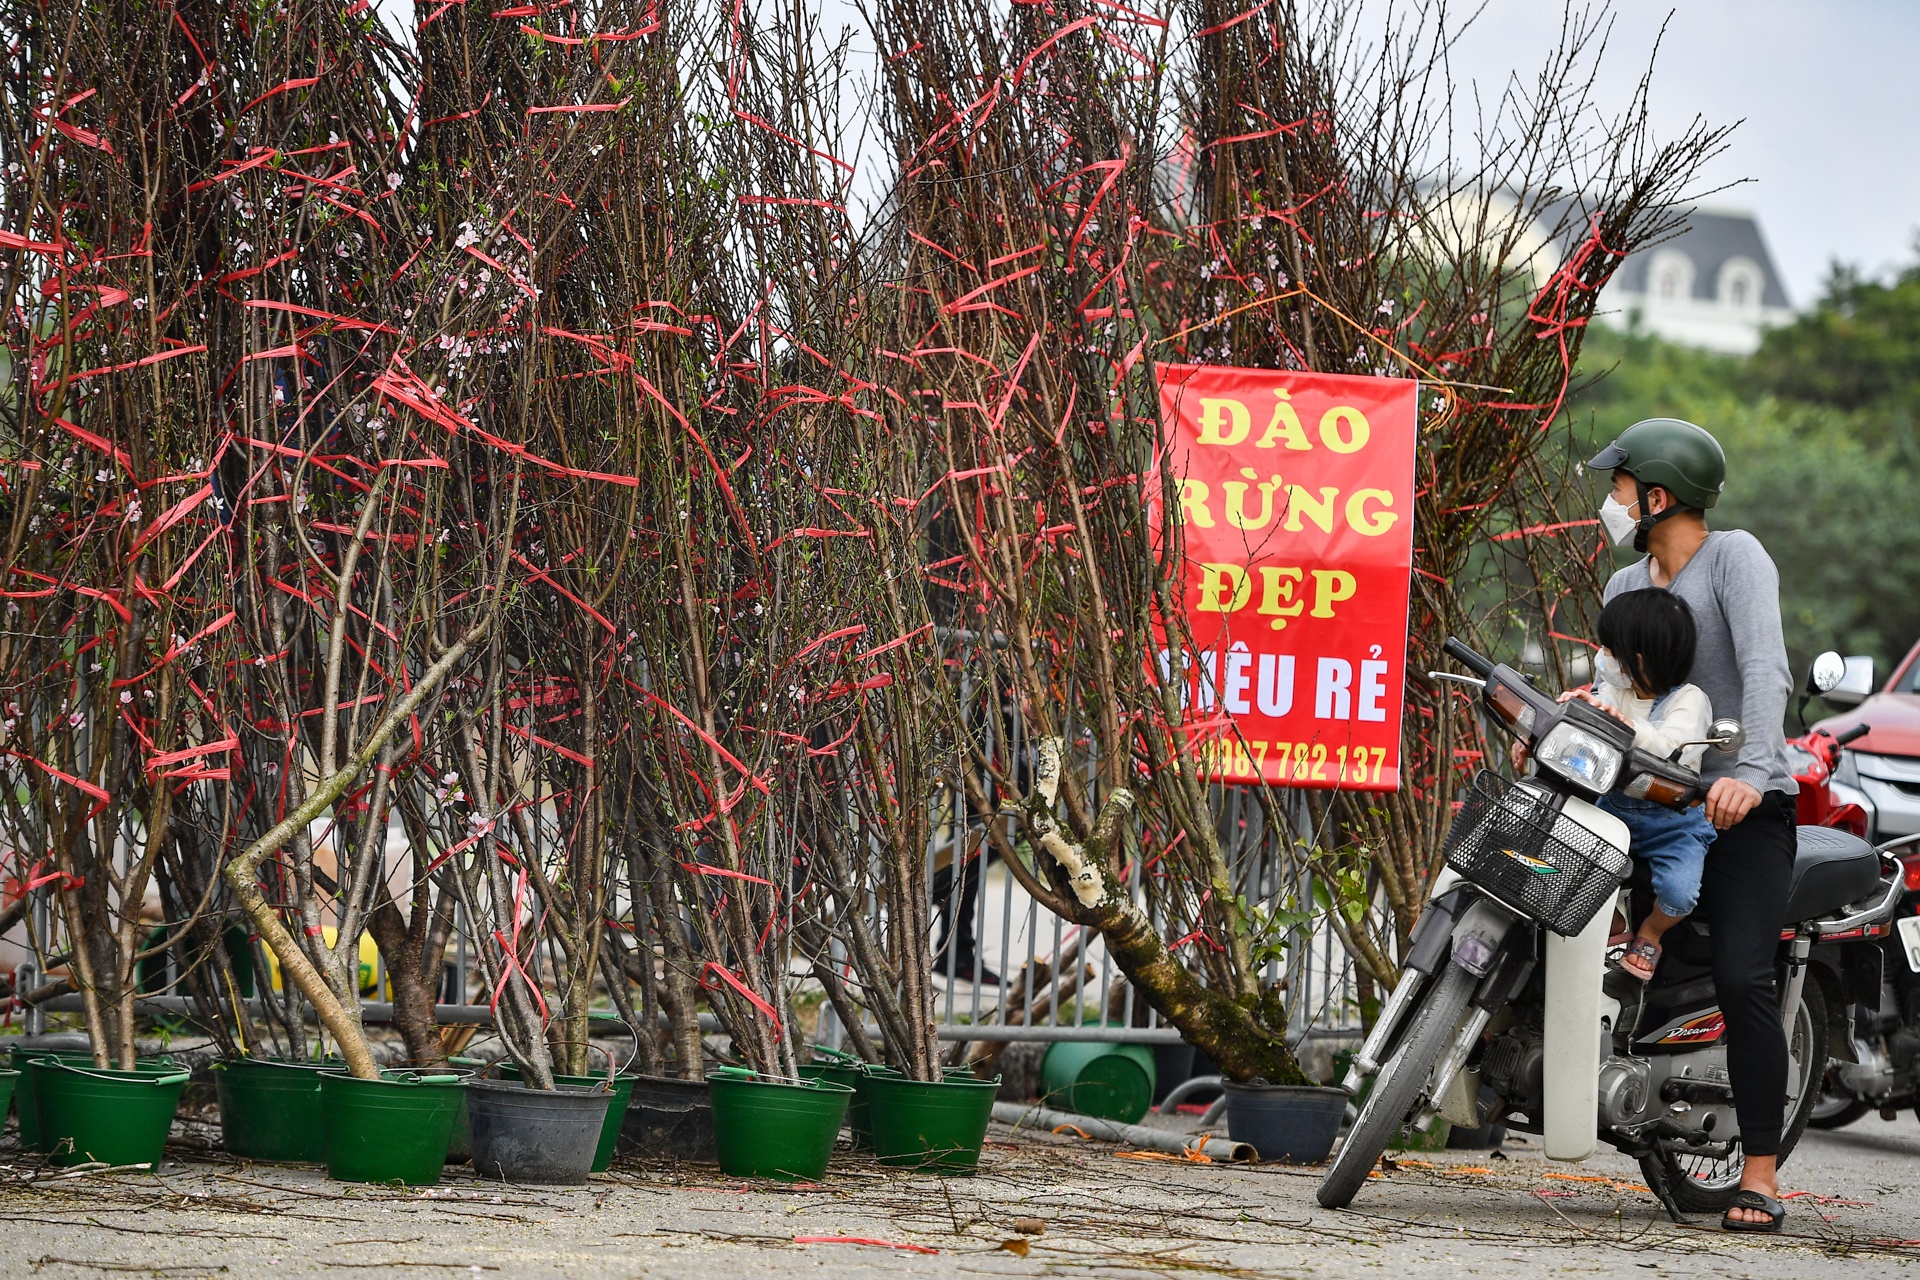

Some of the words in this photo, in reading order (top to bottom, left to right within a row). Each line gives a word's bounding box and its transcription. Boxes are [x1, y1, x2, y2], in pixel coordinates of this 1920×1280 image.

[1197, 388, 1370, 454] ĐÀO
[1170, 467, 1398, 537] RỪNG
[1196, 563, 1357, 631] ĐẸP
[1315, 644, 1388, 722] RẺ
[1276, 742, 1327, 781] 782
[1336, 746, 1386, 783] 137
[1666, 1027, 1713, 1038] Dream
